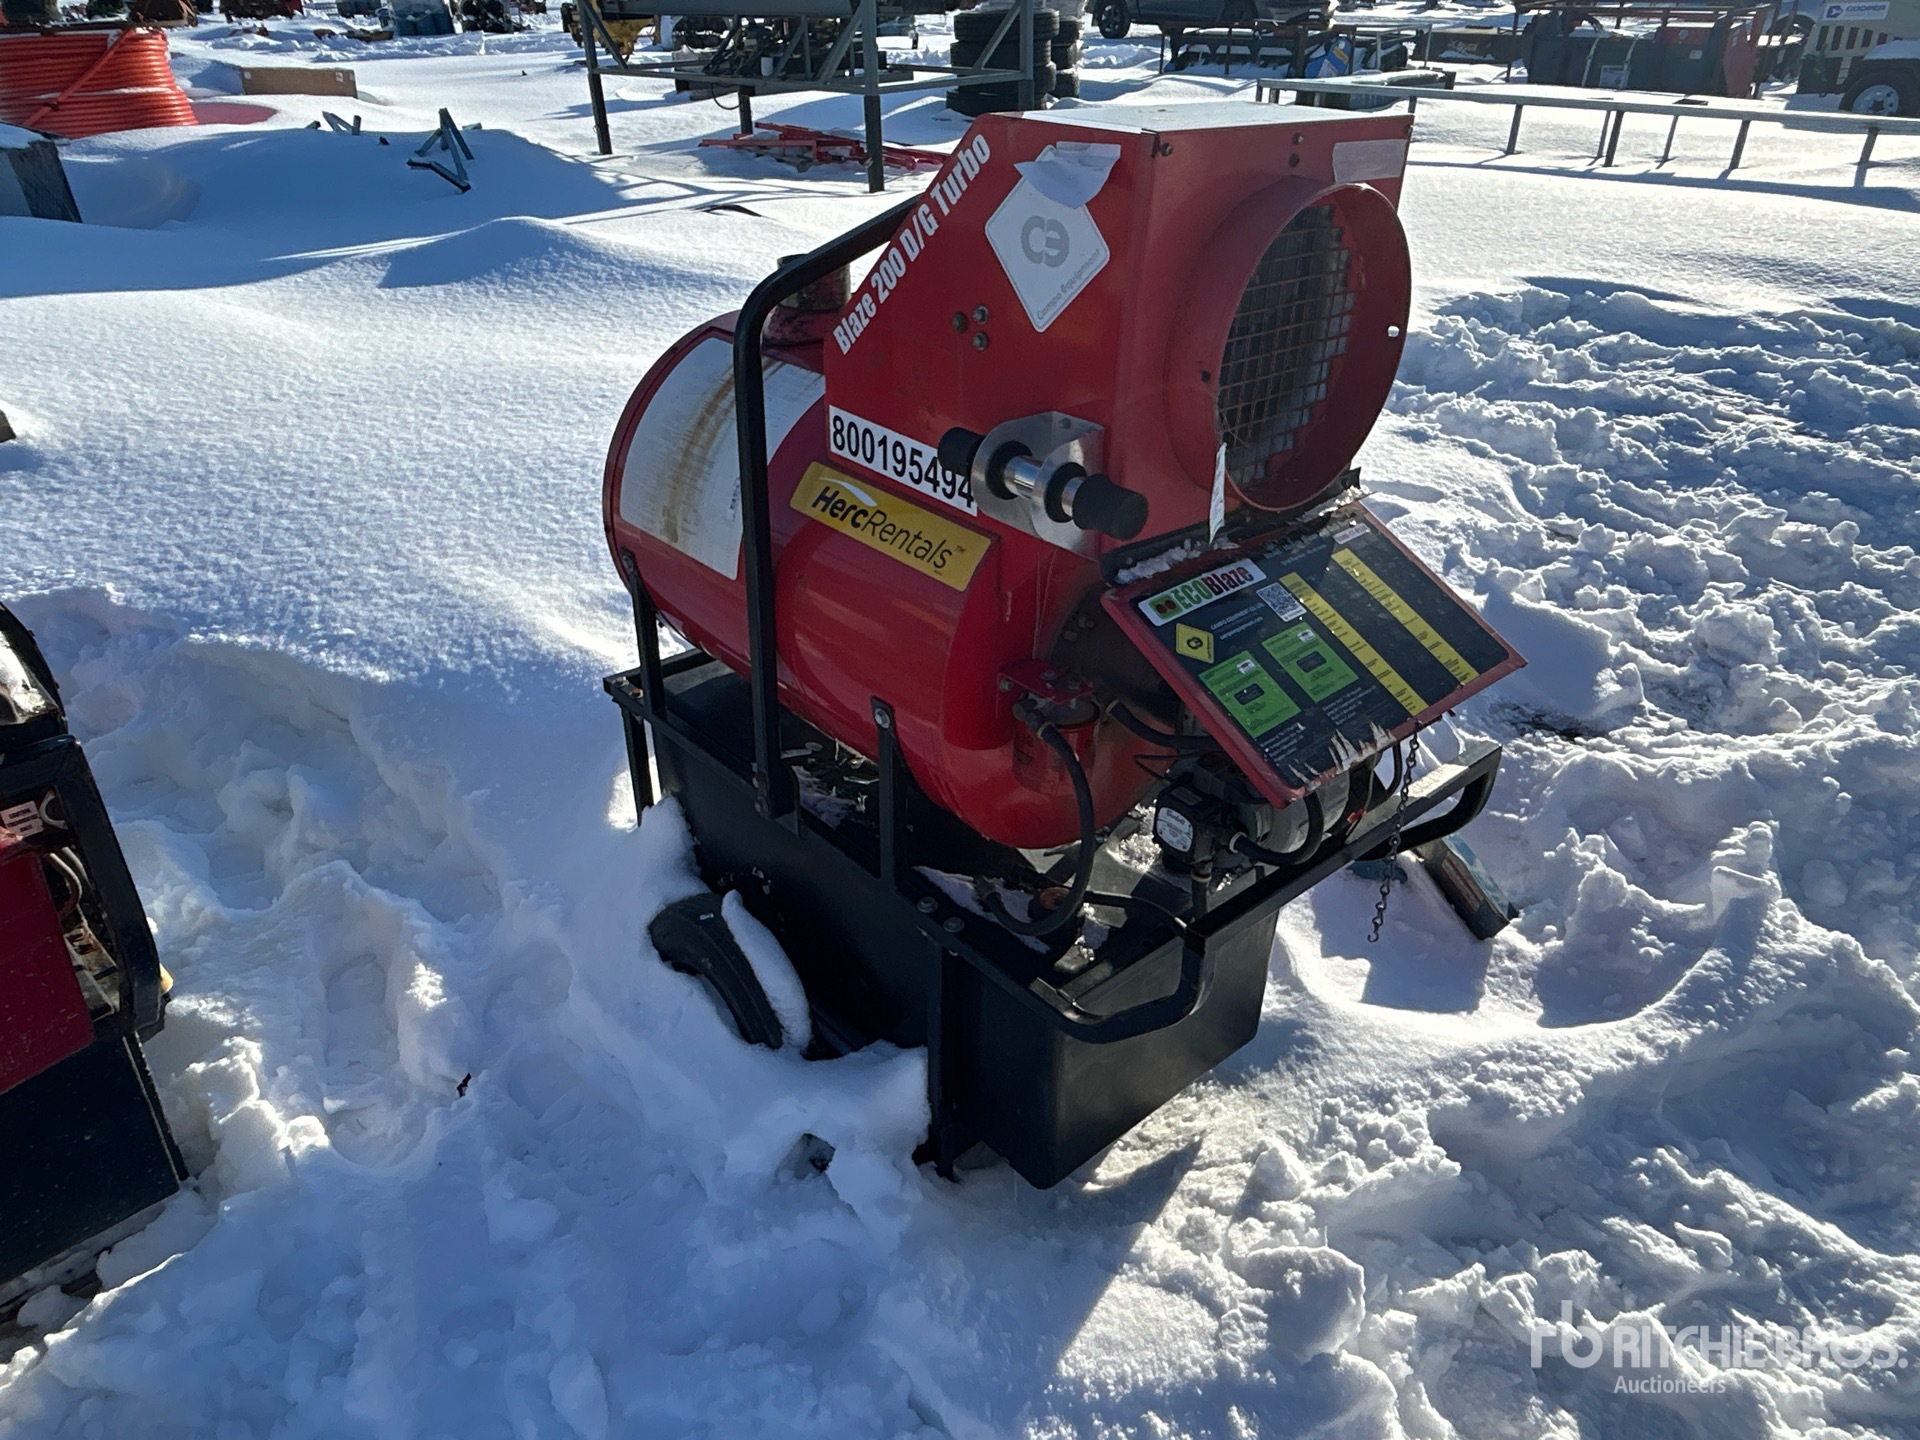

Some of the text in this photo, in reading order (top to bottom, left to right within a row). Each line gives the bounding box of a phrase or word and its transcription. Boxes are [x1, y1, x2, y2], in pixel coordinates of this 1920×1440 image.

[833, 134, 991, 355] Blaze 200 D/G Turbo
[832, 415, 975, 509] 800195494
